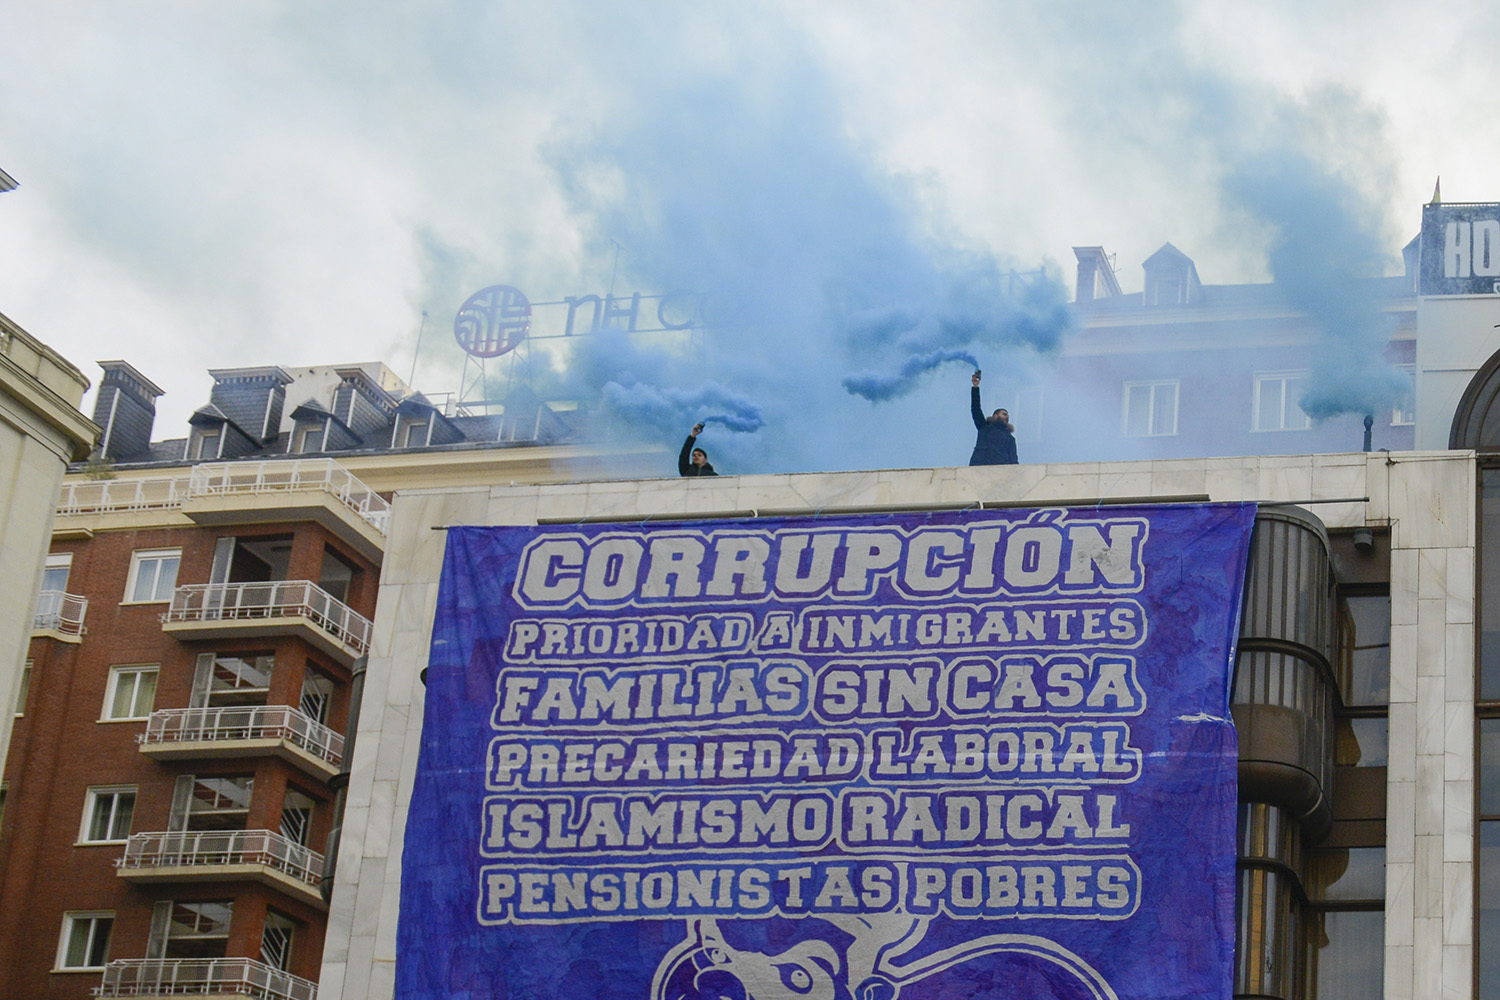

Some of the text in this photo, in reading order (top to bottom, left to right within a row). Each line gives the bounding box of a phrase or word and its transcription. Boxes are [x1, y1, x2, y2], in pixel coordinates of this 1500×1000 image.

[522, 510, 1139, 601] CORRUPCIÓN
[511, 608, 1136, 655] PRIORIDAD A INMIGRANTES
[500, 663, 1136, 722] FAMILIAS SIN CASA
[495, 731, 1133, 783] PRECARIEDAD LABORAL
[487, 794, 1130, 849] ISLAMISMO RADICAL
[486, 865, 1131, 914] PENSIONISTAS POBRES
